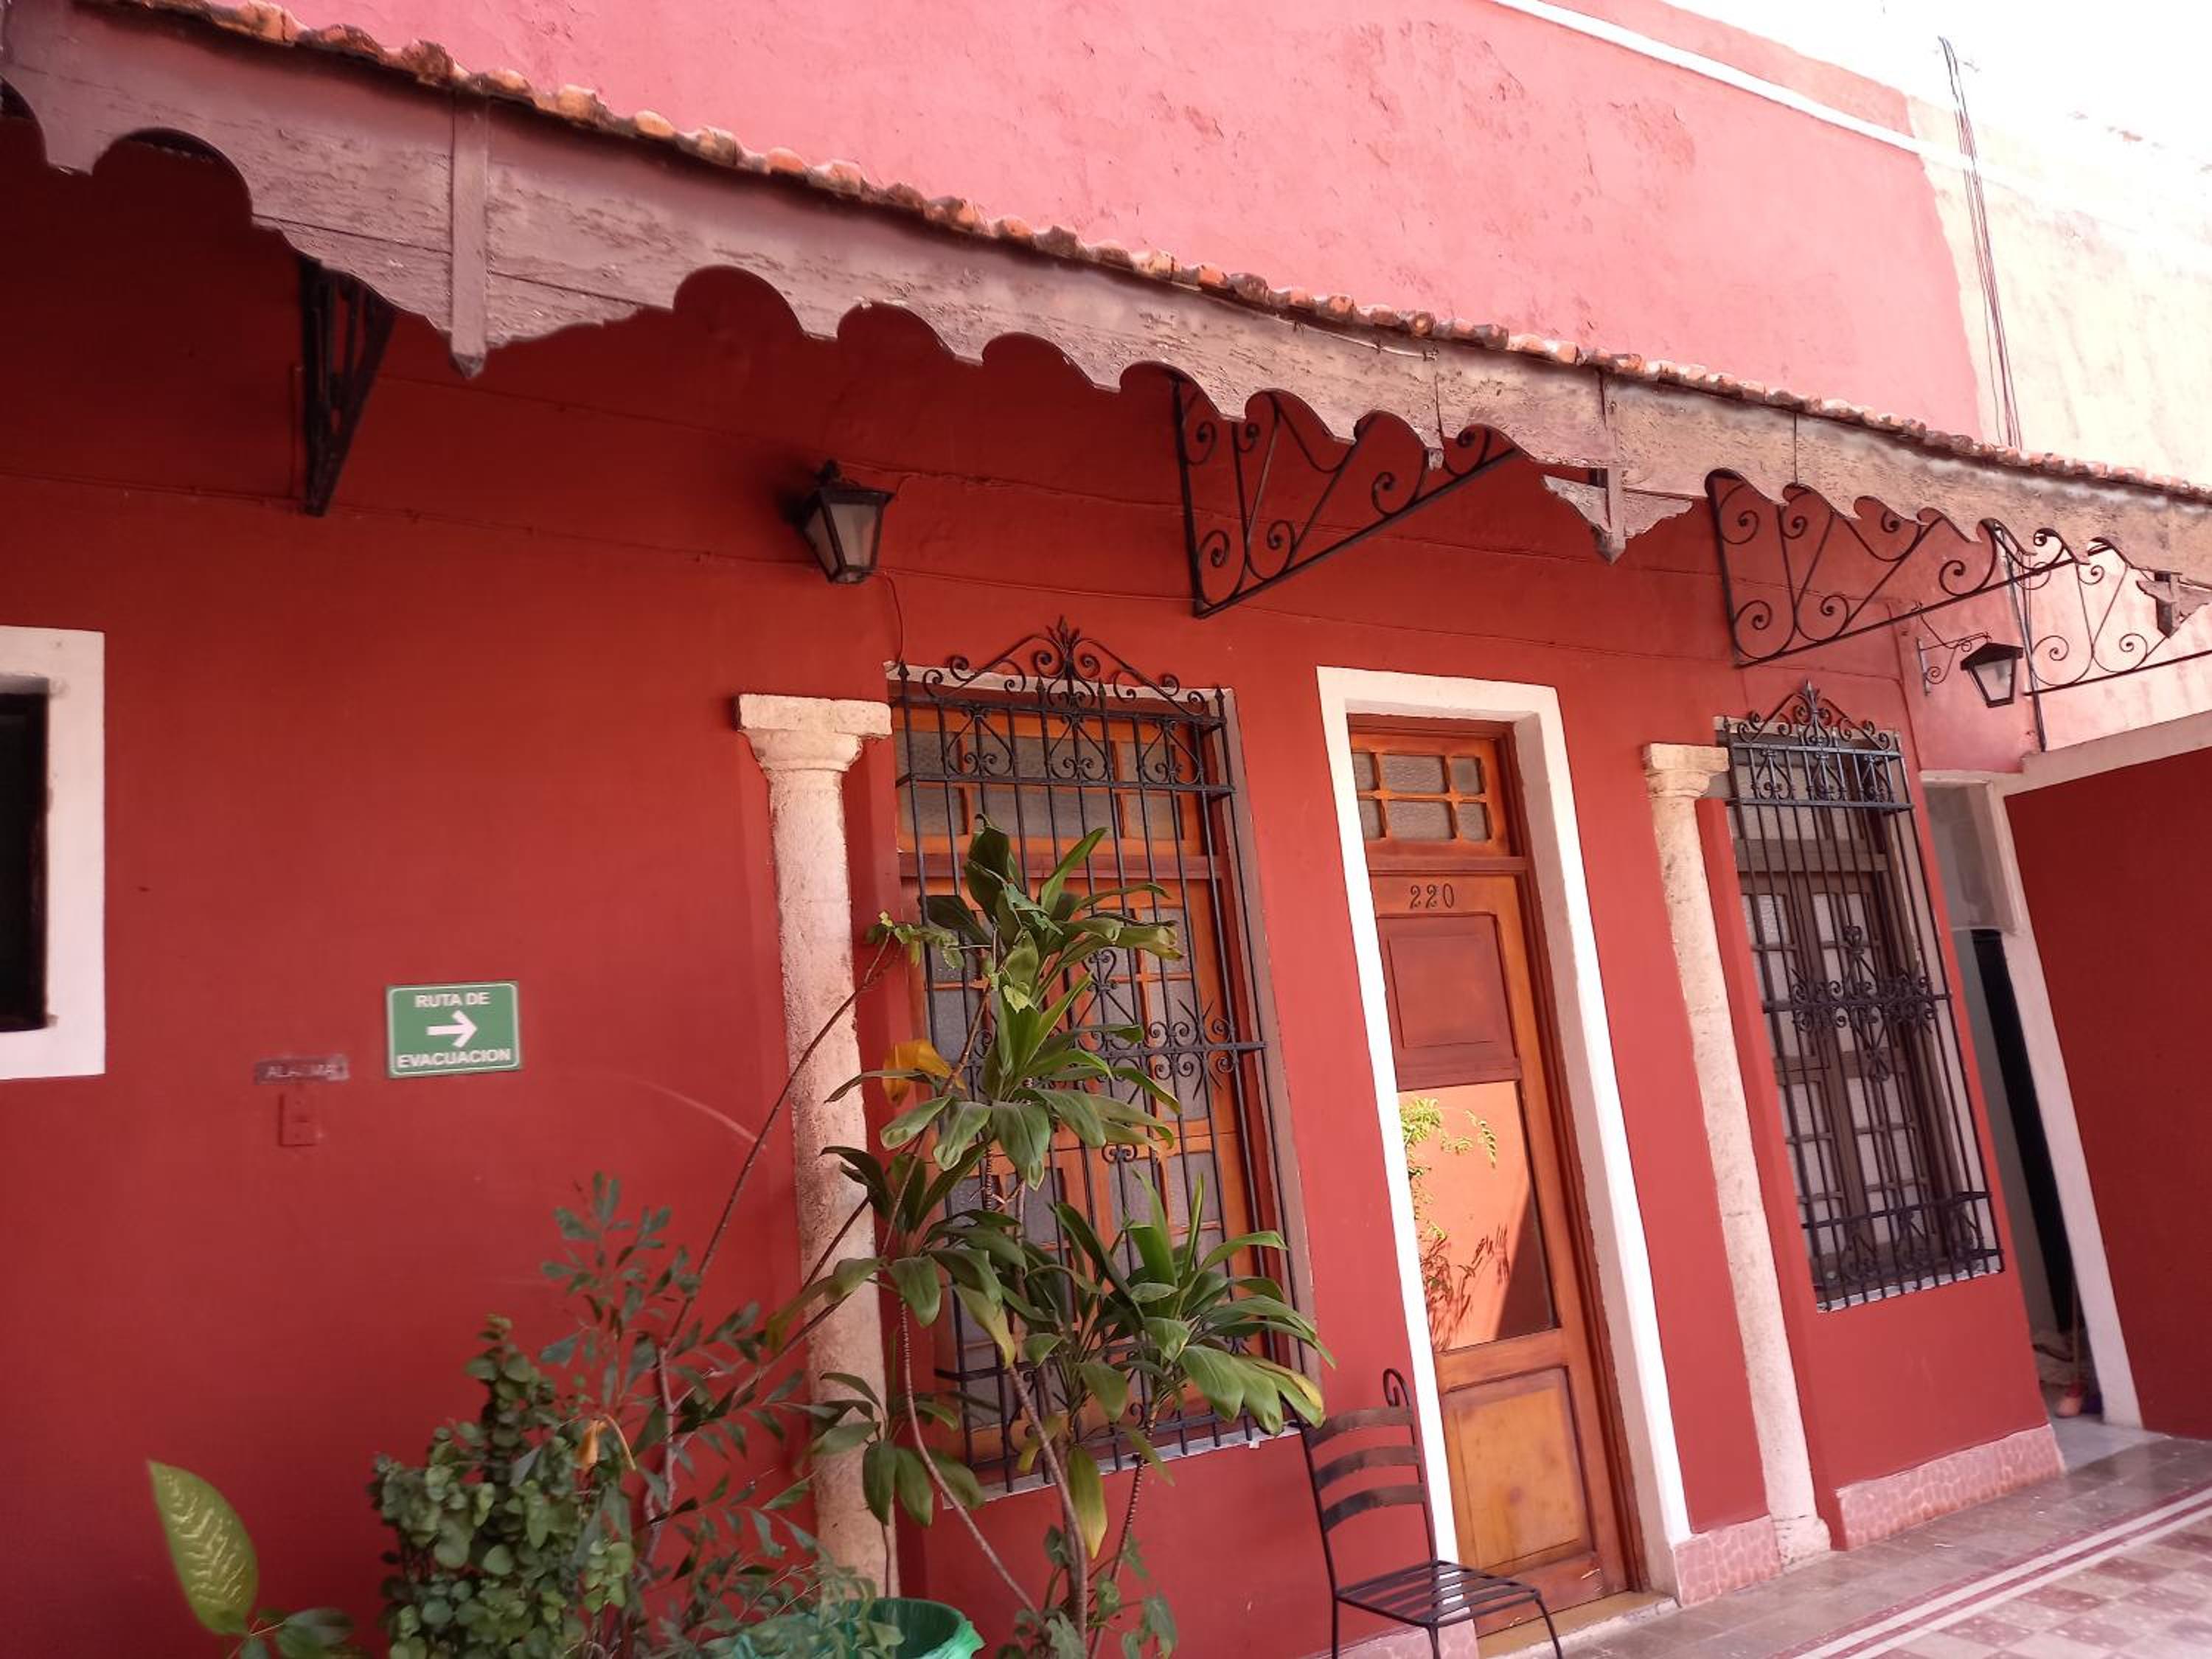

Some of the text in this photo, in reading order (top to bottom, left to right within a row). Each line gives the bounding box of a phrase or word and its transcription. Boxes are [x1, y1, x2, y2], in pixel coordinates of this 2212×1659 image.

[1409, 883, 1455, 908] 220
[414, 992, 490, 1007] RUTA DE
[397, 1048, 511, 1068] EVACUACION
